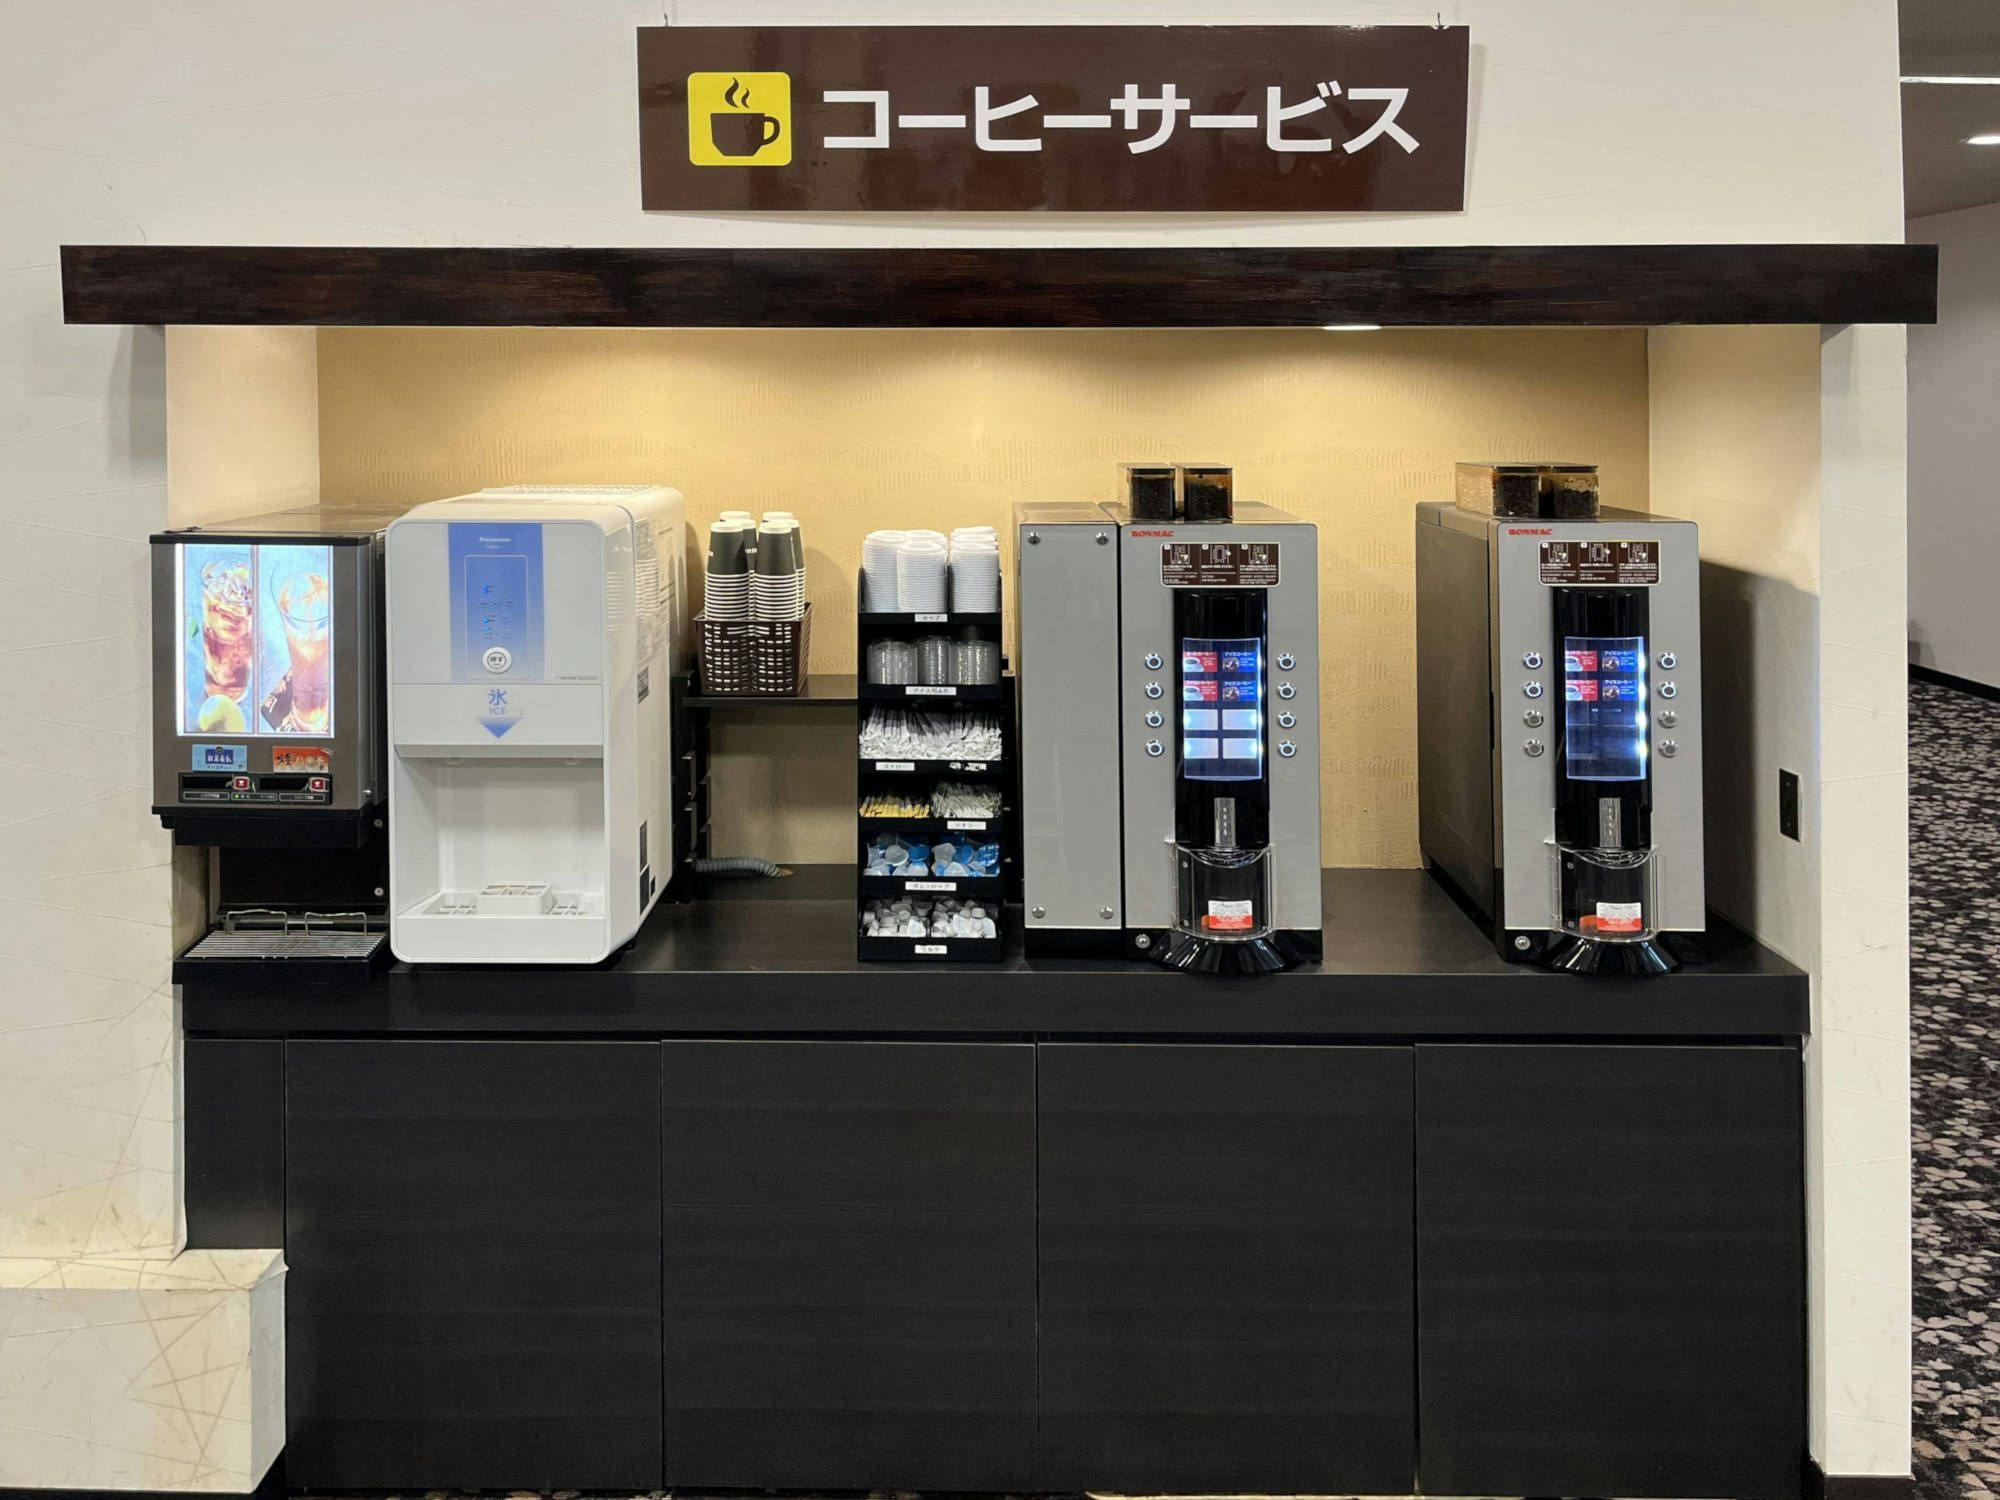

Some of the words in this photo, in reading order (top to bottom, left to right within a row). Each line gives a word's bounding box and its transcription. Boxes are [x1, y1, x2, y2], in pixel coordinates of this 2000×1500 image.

[822, 81, 1421, 154] コーヒーサービス
[1130, 530, 1175, 538] BONMAC
[1508, 528, 1553, 536] BONMAC
[488, 688, 508, 706] 氷
[489, 707, 506, 715] ICE
